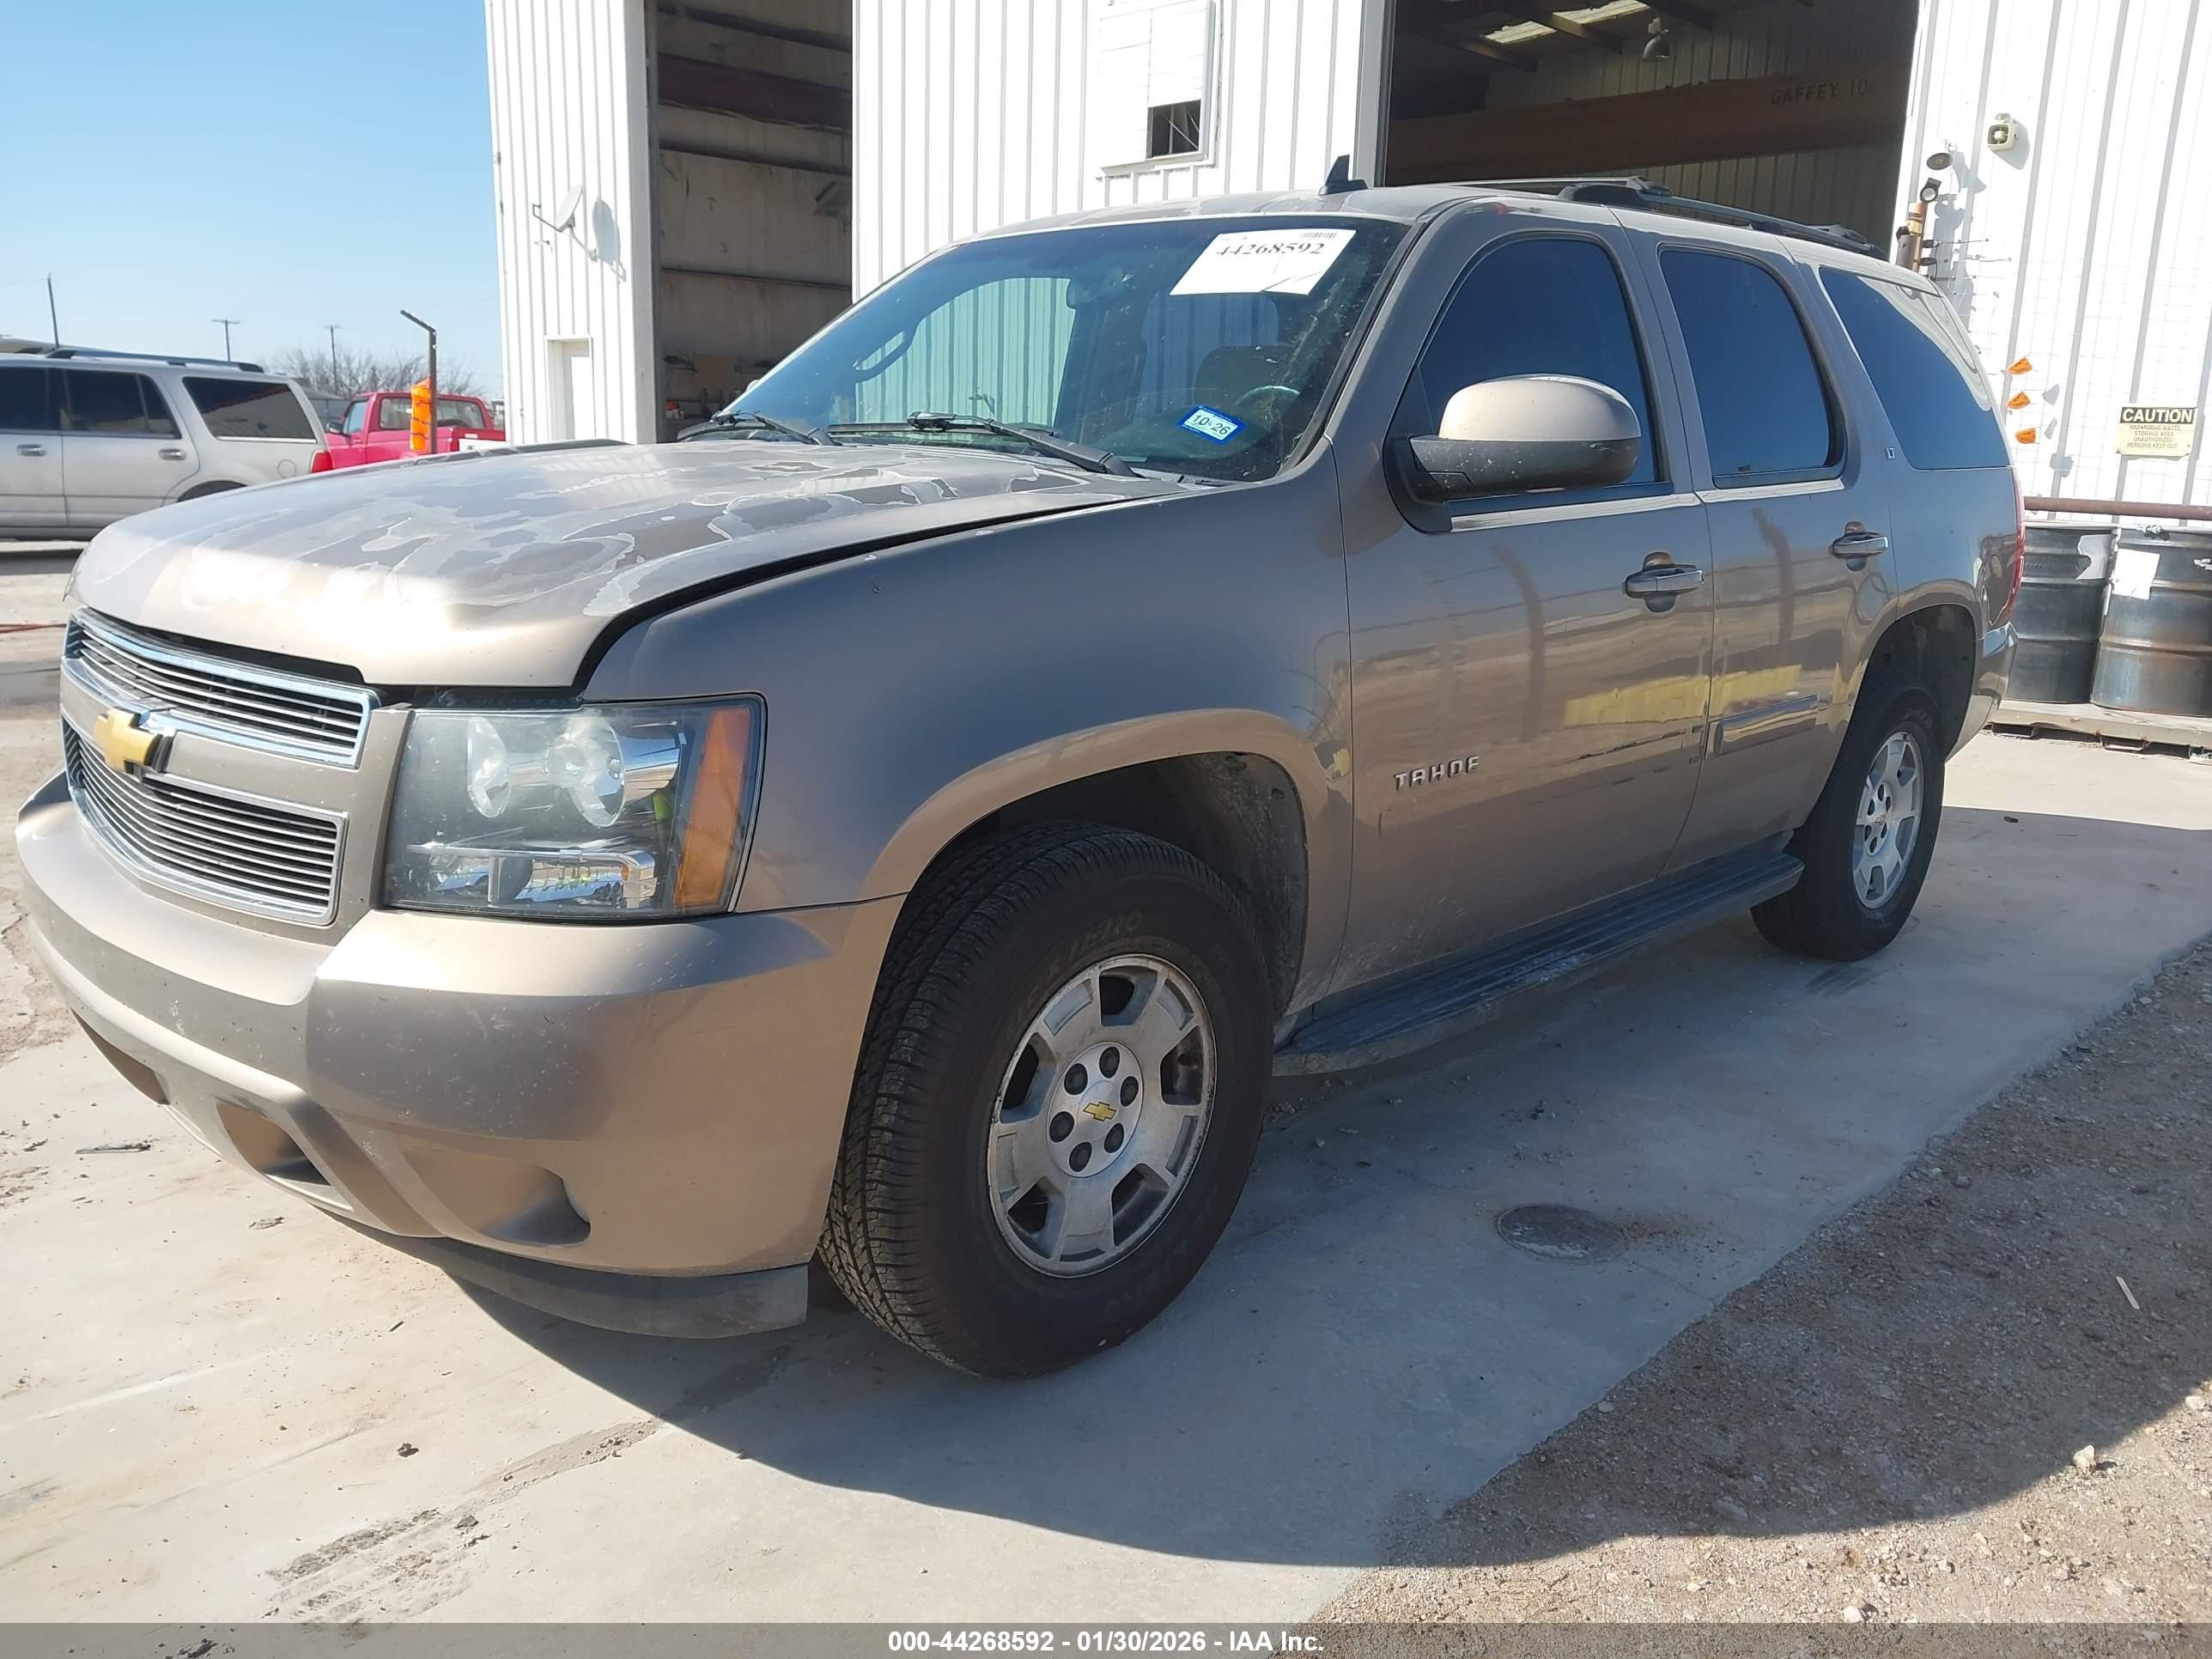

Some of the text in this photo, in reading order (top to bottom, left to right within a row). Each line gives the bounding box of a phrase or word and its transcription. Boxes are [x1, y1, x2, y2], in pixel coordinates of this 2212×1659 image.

[1771, 82, 1839, 104] GAFFEY
[1216, 242, 1325, 255] 44268592
[2123, 409, 2192, 422] CAUTION
[1393, 755, 1479, 790] TAHOE
